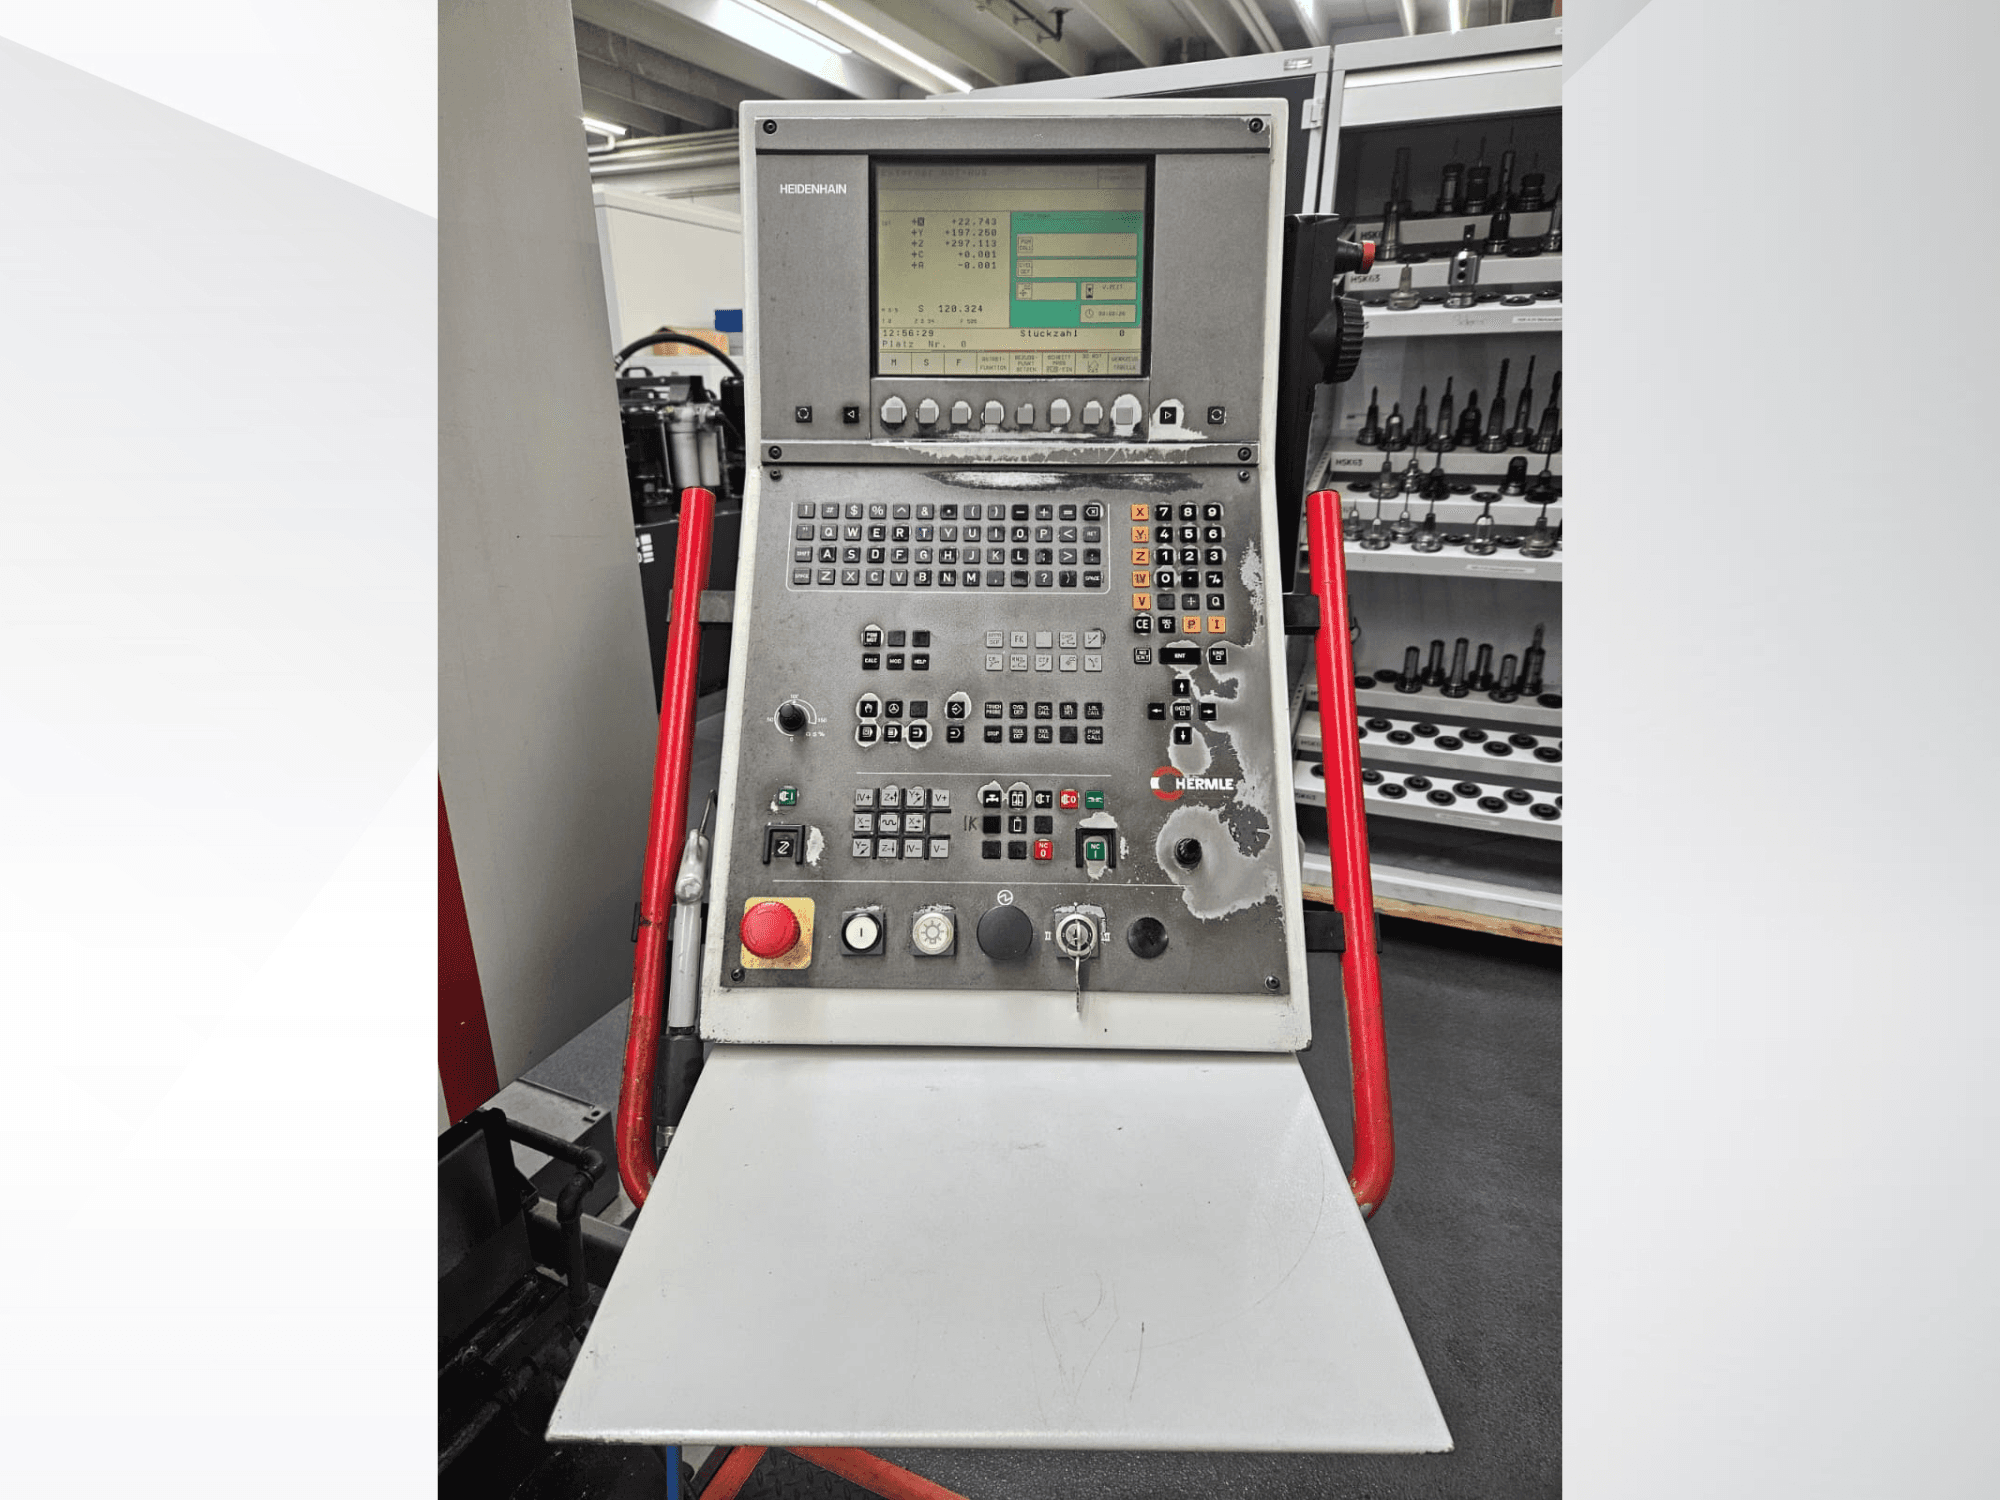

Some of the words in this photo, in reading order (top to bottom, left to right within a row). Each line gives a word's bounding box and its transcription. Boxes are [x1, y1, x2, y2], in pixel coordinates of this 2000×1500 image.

[780, 184, 847, 194] HEIDENHAIN
[952, 218, 996, 226] +22.743
[918, 304, 924, 313] S
[939, 304, 982, 313] 120.324
[1136, 508, 1144, 516] X
[1160, 508, 1168, 516] 7
[1184, 508, 1192, 516] 8
[1209, 508, 1217, 516] 9
[825, 528, 832, 536] Q
[848, 528, 858, 536] W
[873, 528, 880, 538] E
[897, 528, 904, 537] R
[922, 528, 927, 538] T
[944, 528, 952, 537] Y
[968, 528, 976, 537] U
[1040, 529, 1047, 538] P
[1136, 529, 1145, 539] Y
[1160, 530, 1169, 538] 4
[1185, 530, 1193, 538] 5
[1209, 530, 1217, 538] 6
[823, 549, 832, 558] A
[848, 550, 855, 559] S
[872, 549, 879, 558] D
[896, 550, 903, 559] F
[920, 550, 927, 559] G
[944, 551, 952, 560] H
[969, 551, 974, 560] J
[993, 551, 1000, 560] K
[1017, 551, 1023, 560] L
[1136, 552, 1145, 561] Z
[1162, 552, 1168, 560] 1
[1185, 552, 1194, 561] 2
[1210, 552, 1218, 561] 3
[821, 572, 831, 580] Z
[846, 572, 855, 581] X
[871, 572, 878, 581] C
[895, 572, 903, 581] V
[919, 572, 926, 582] B
[943, 573, 951, 582] N
[967, 573, 976, 582] M
[1138, 597, 1146, 606] V
[1212, 597, 1220, 606] Q
[1136, 619, 1149, 629] CE
[1188, 620, 1196, 629] P
[1176, 778, 1234, 790] HERMLE
